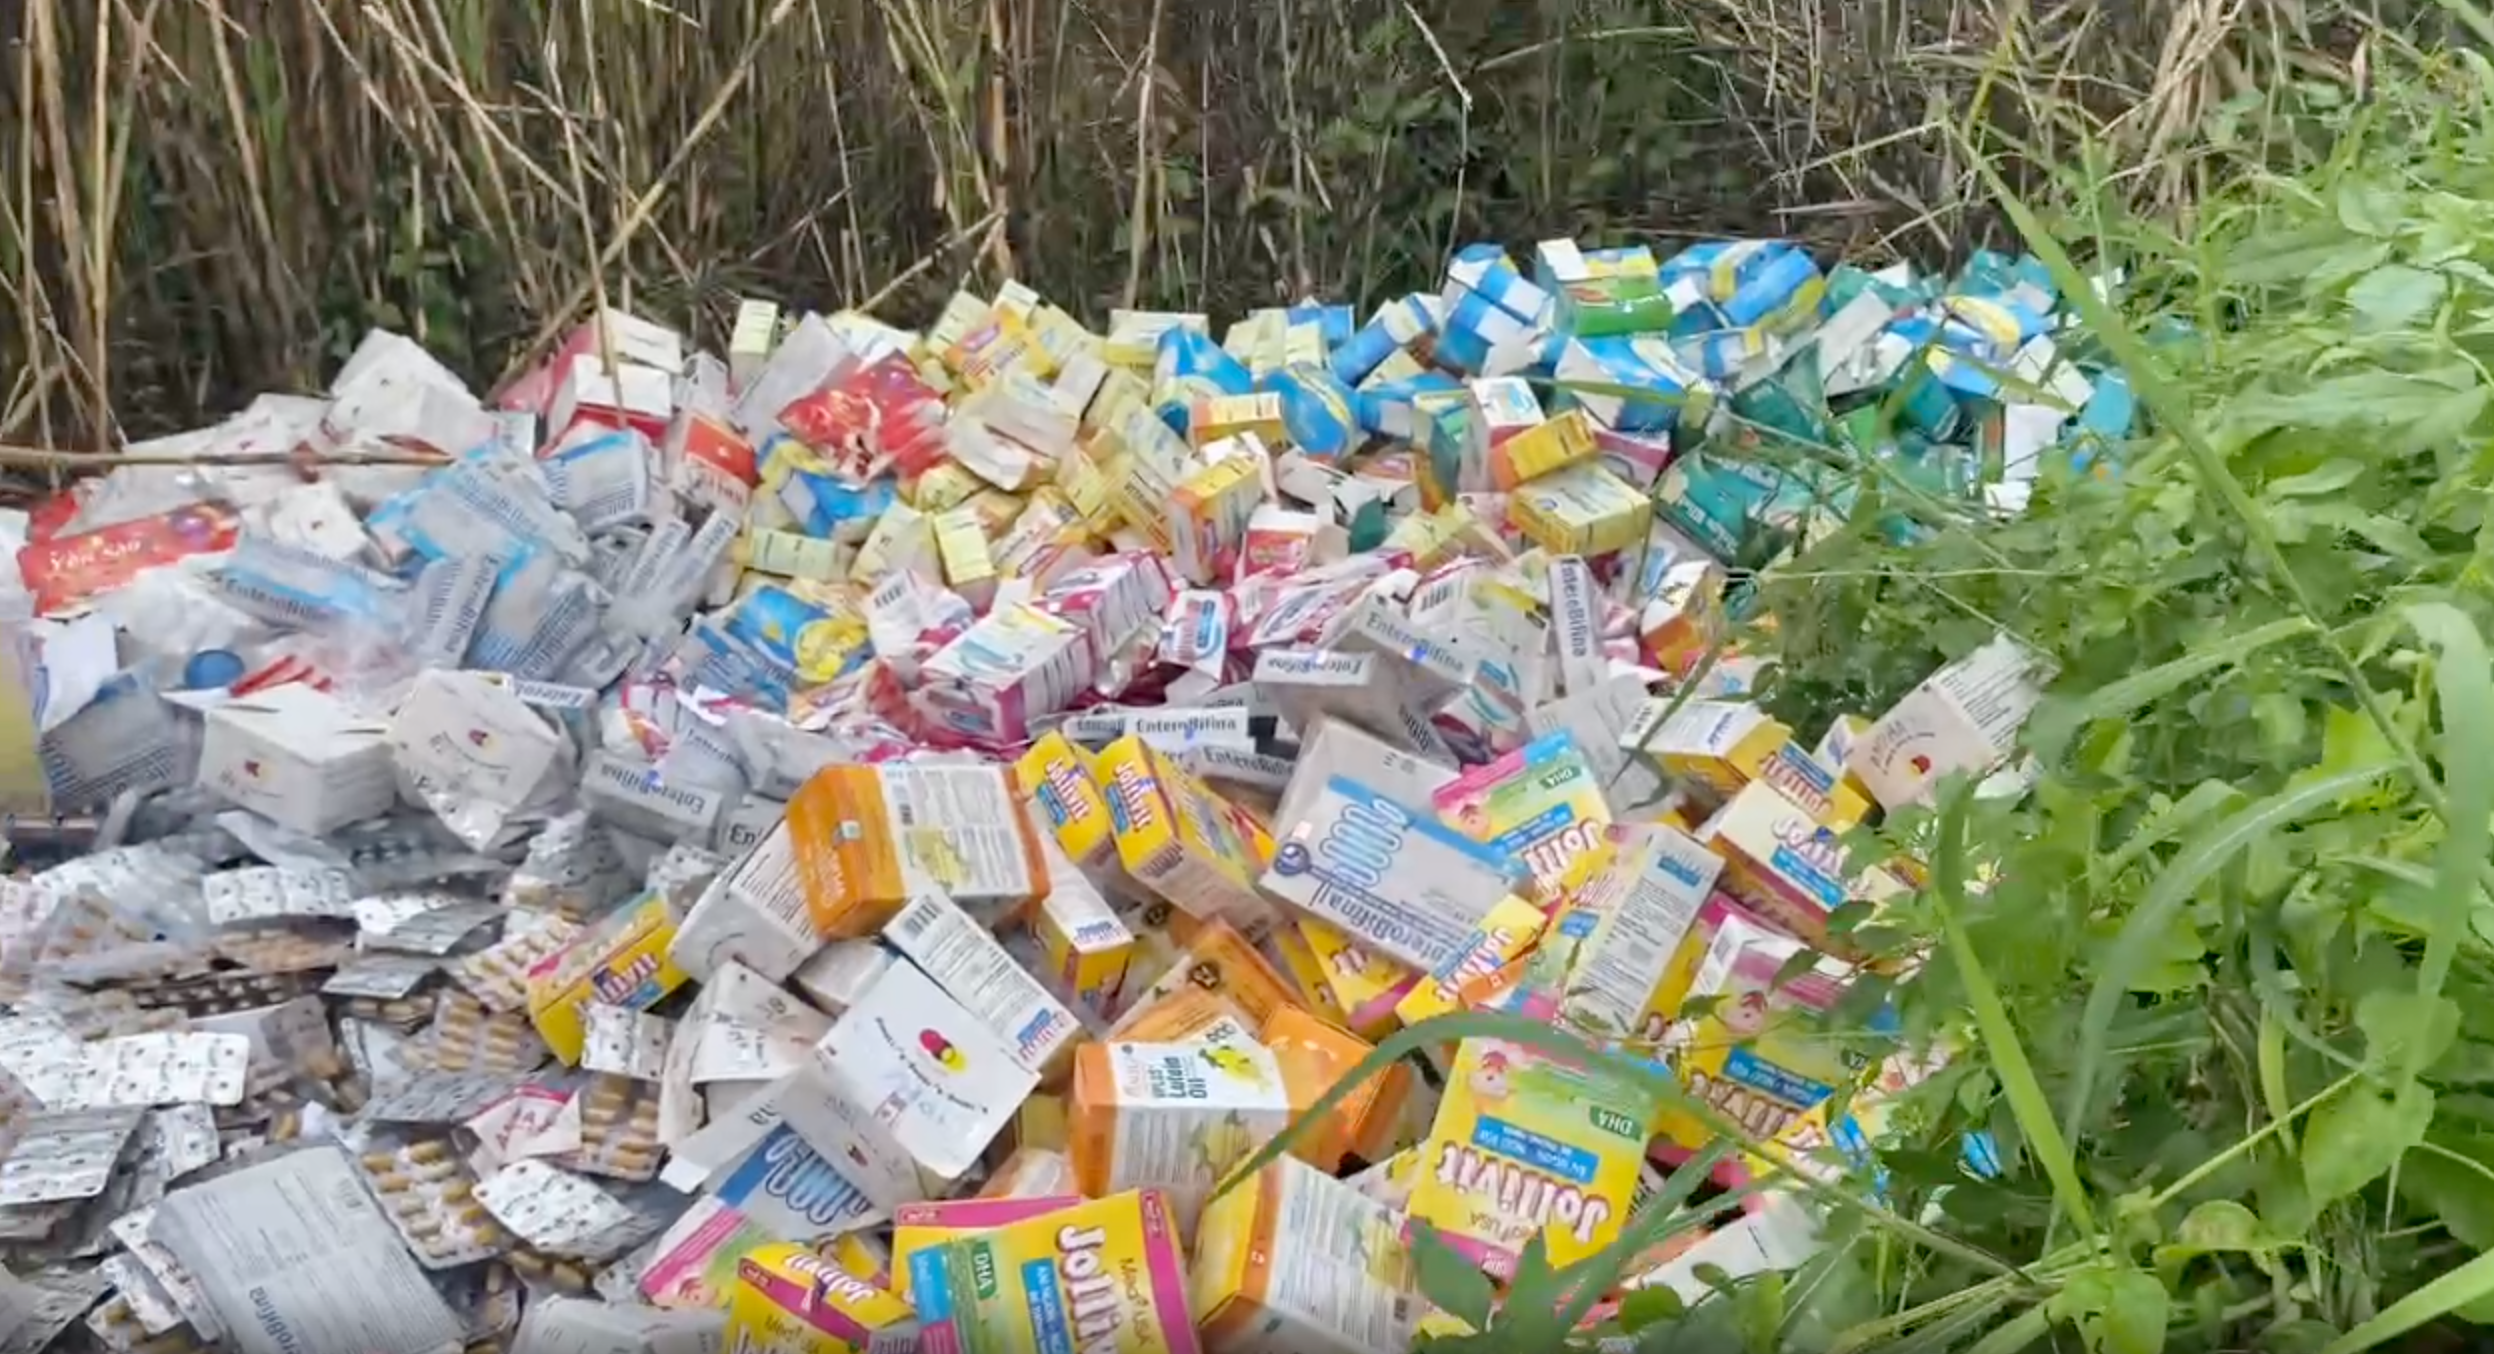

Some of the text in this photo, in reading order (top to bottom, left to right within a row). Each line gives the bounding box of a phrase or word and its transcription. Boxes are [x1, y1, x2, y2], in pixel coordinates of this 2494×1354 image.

[1598, 1108, 1635, 1136] DHA
[1435, 1140, 1611, 1244] Jollivit
[973, 1250, 994, 1299] DHA
